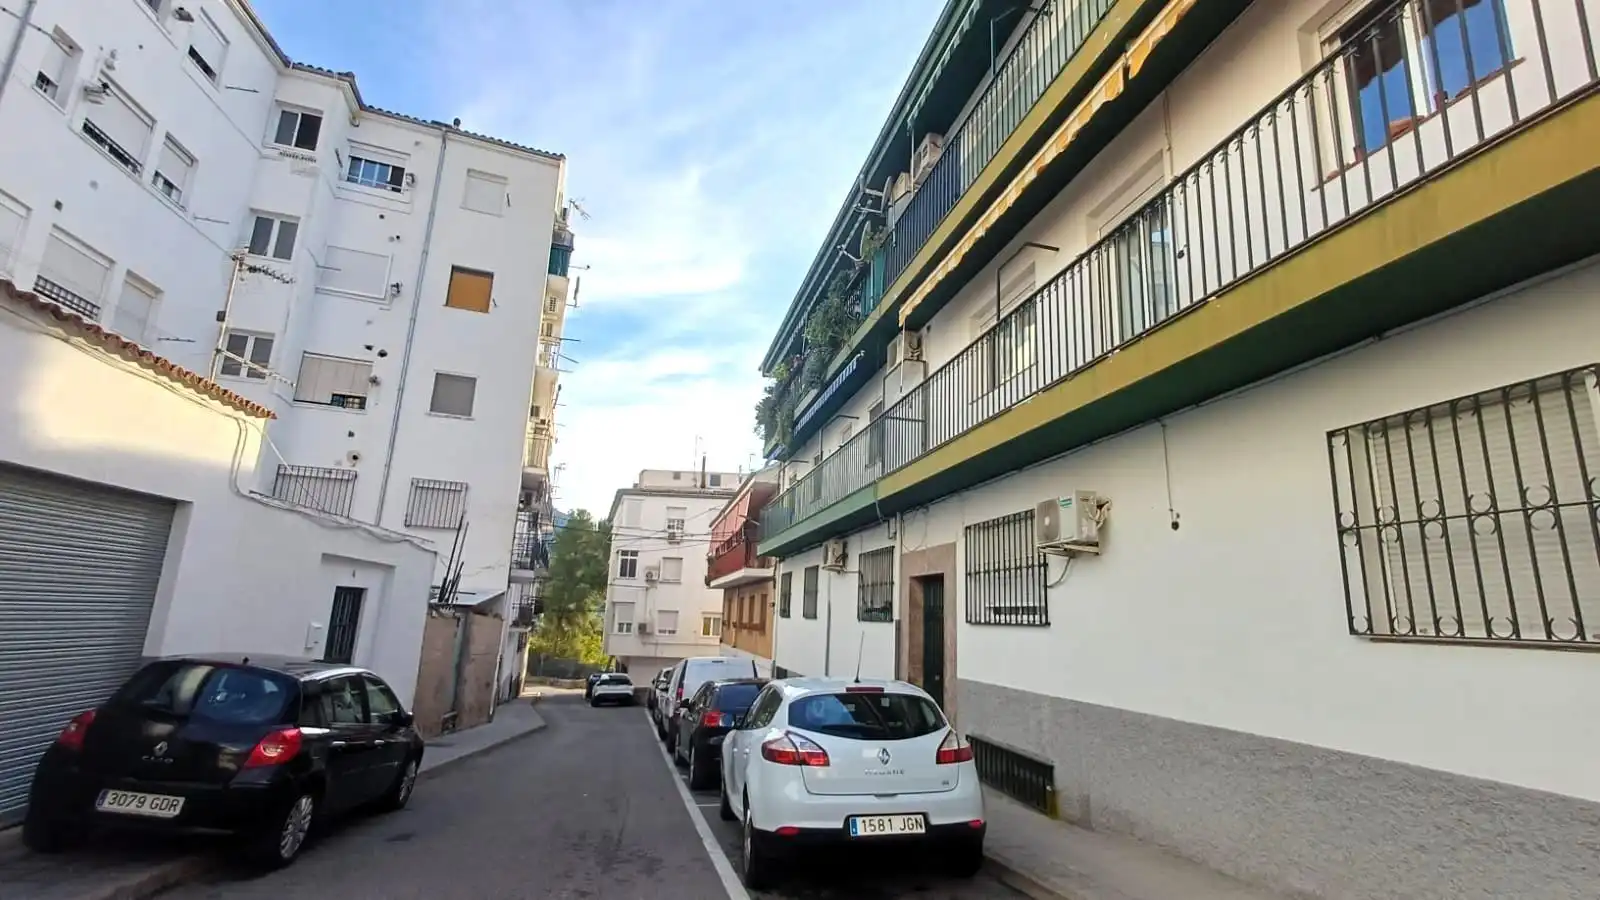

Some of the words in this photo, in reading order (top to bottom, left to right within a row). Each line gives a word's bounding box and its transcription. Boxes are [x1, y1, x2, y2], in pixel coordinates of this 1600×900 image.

[108, 792, 147, 808] 3079
[150, 797, 180, 812] GDR
[861, 818, 894, 832] 1581
[900, 817, 924, 831] JGN
